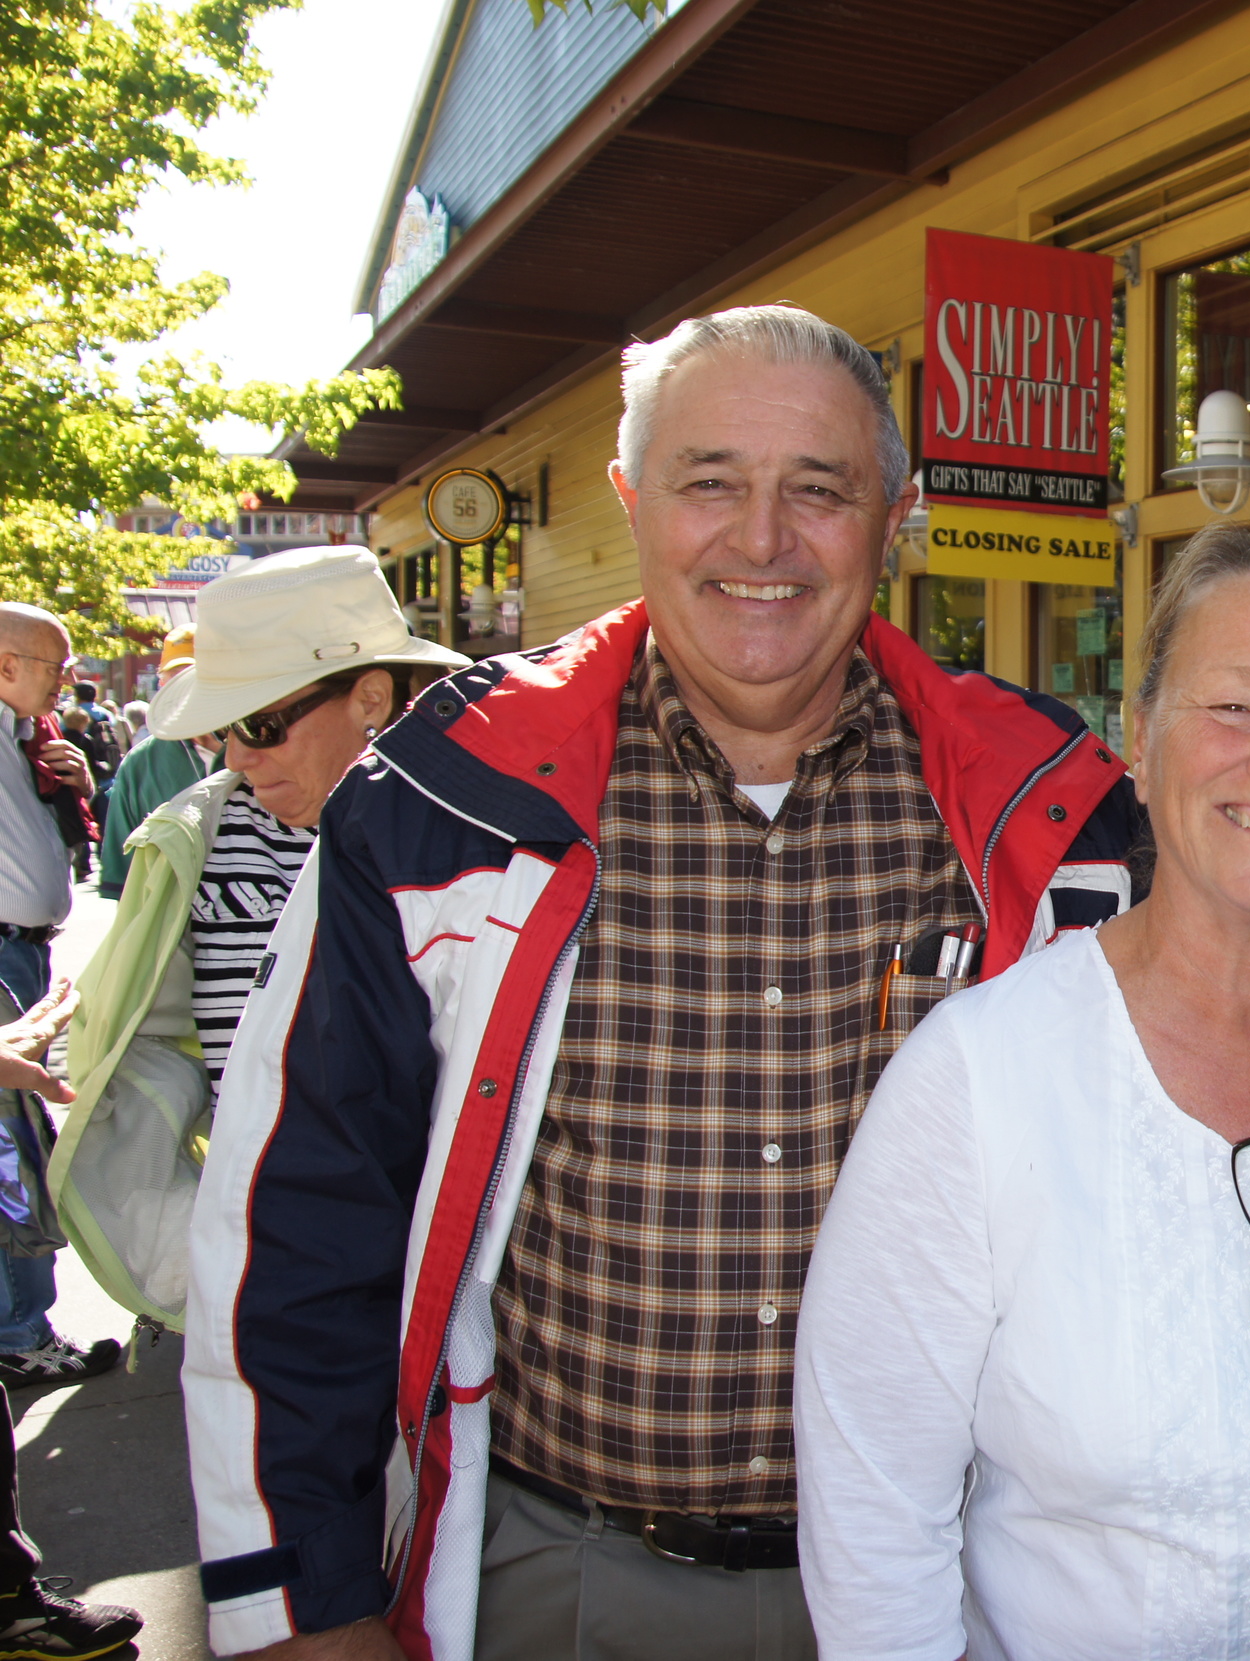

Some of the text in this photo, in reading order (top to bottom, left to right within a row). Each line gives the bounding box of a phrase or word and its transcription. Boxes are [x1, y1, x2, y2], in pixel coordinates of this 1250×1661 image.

[936, 298, 1101, 440] SIMPLY!
[936, 374, 1100, 455] SEATTLE
[452, 486, 476, 497] CAFE
[930, 465, 1101, 502] GIFTS THAT SAY "SEATTLE"
[453, 498, 476, 517] 56
[931, 527, 1112, 560] CLOSING SALE
[168, 556, 231, 572] AGOSY
